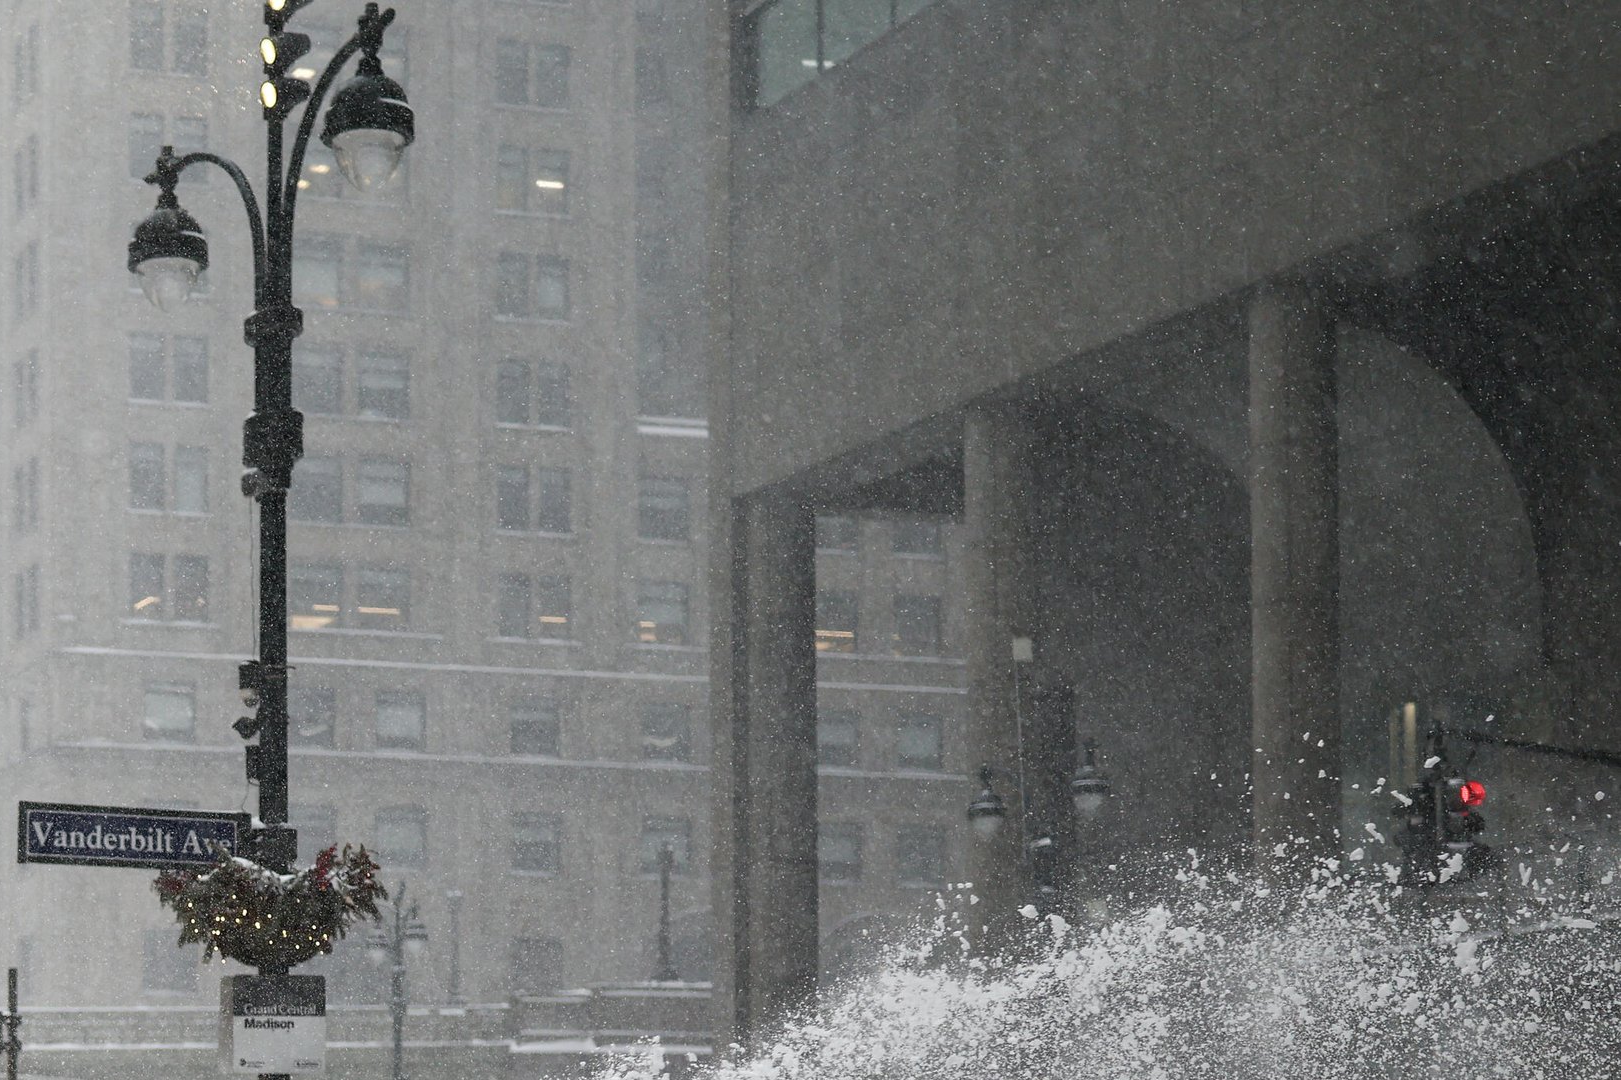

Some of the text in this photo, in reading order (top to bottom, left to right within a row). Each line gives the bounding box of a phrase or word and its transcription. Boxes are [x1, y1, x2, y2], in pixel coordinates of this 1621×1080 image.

[32, 820, 174, 853] Vanderbilt
[244, 1003, 317, 1015] Grand Central
[244, 1018, 295, 1030] Madison
